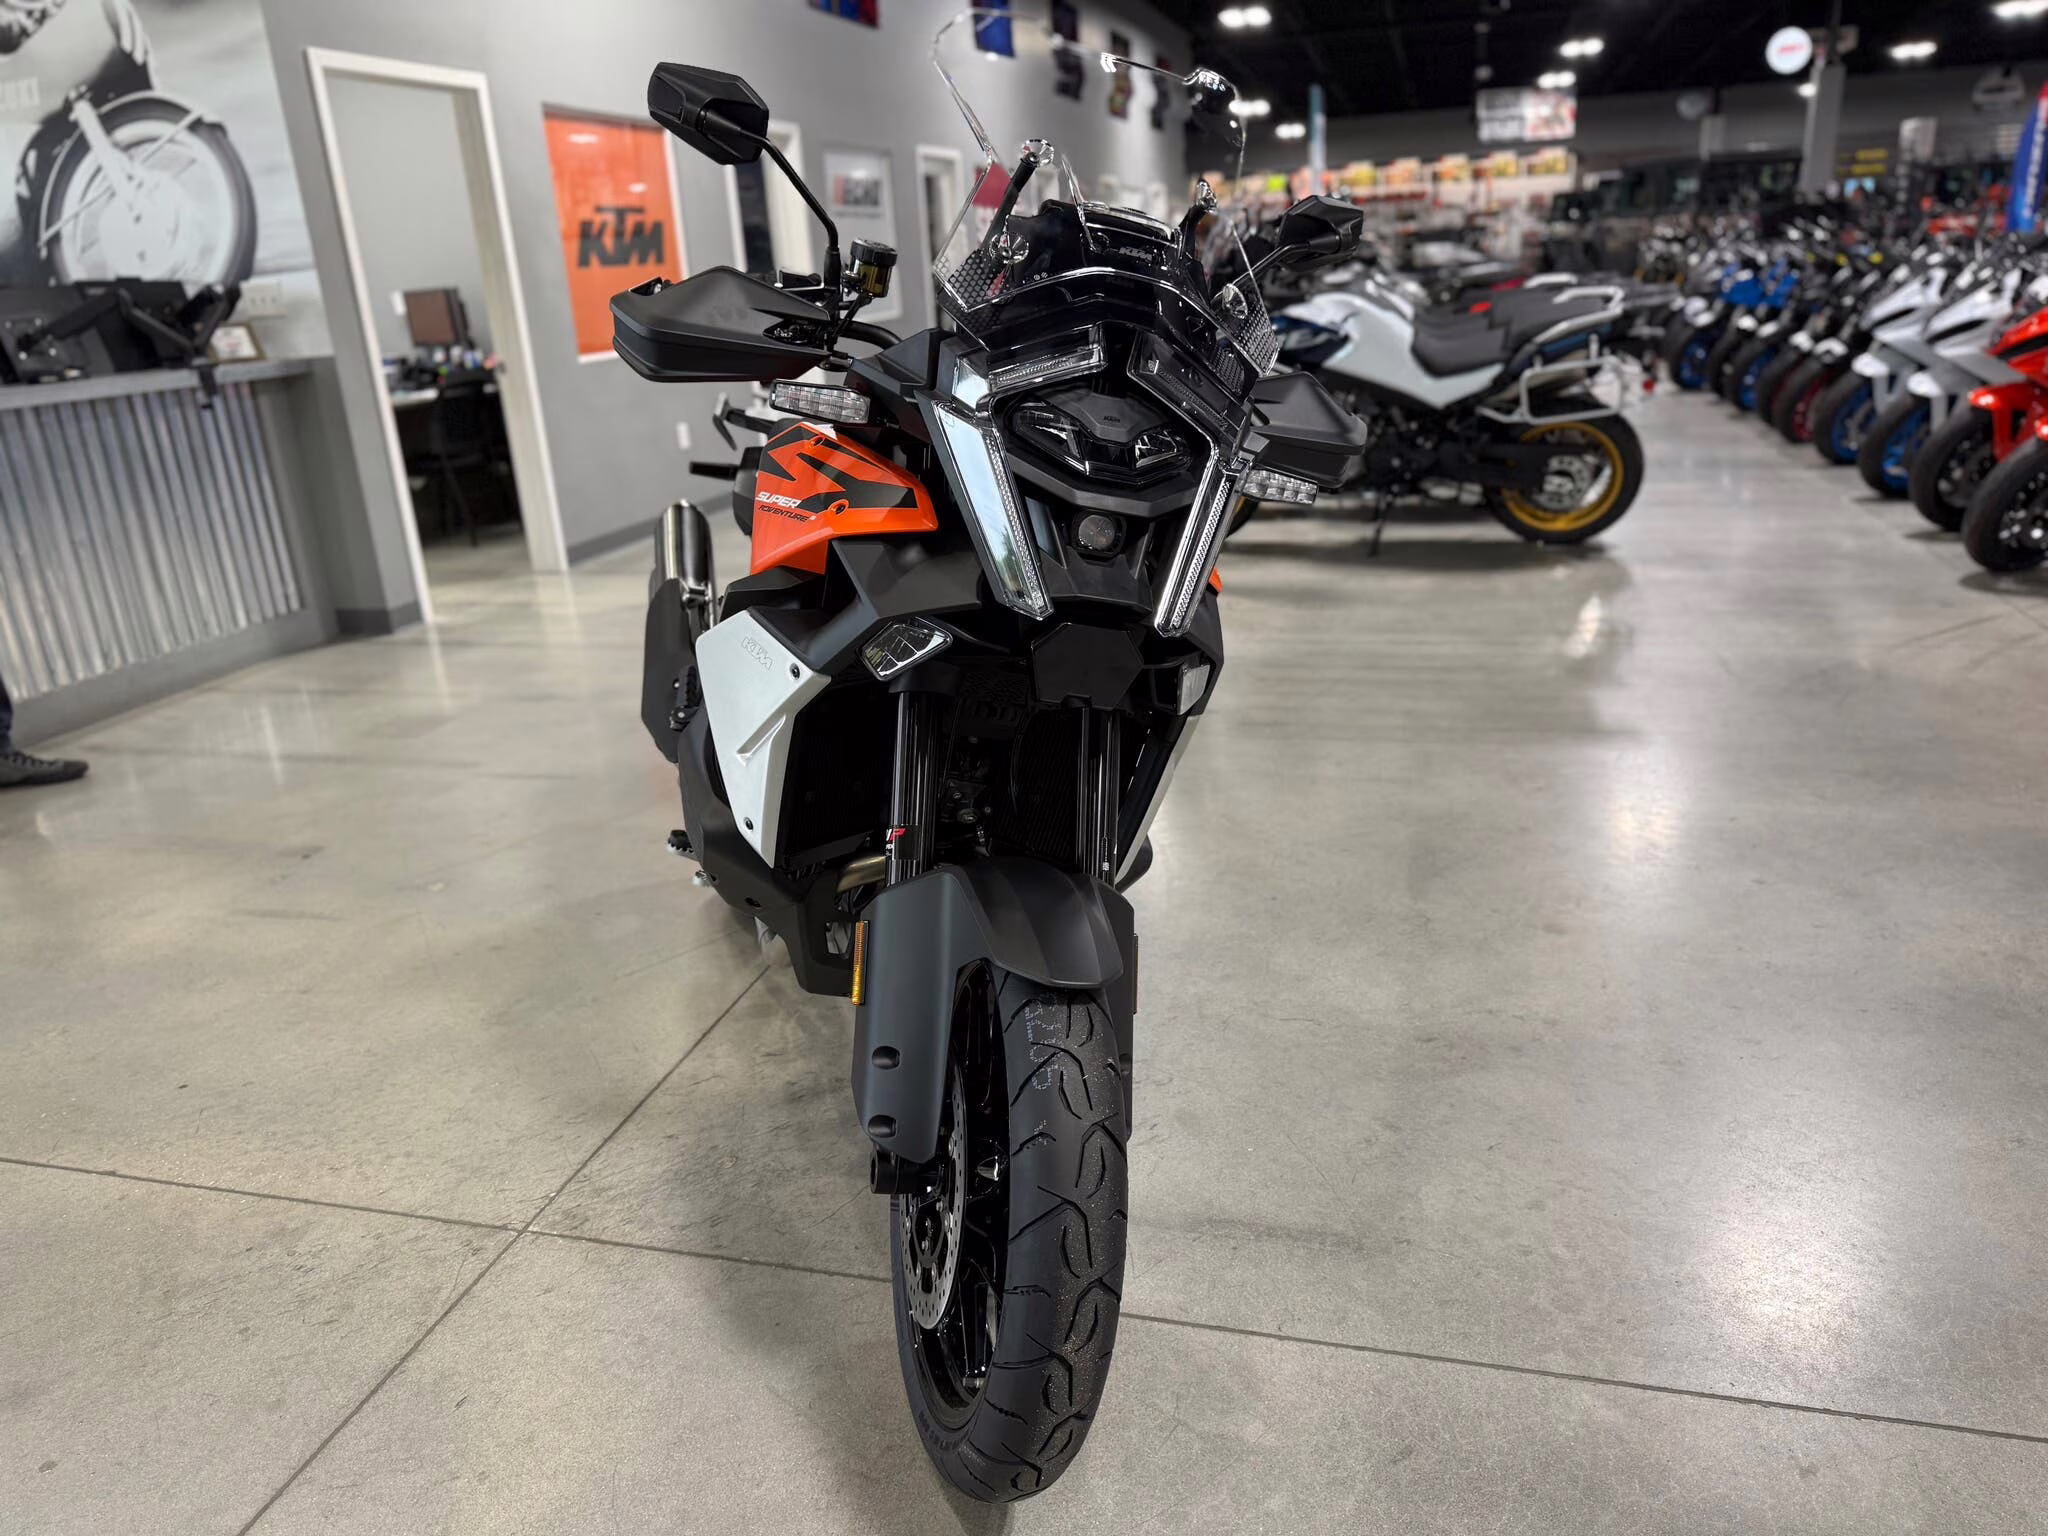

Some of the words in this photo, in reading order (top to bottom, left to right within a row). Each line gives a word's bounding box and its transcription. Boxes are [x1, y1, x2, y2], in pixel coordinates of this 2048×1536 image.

[578, 205, 664, 268] KTM
[755, 491, 802, 509] SUPER
[758, 504, 809, 522] ADVENTURE
[741, 636, 774, 670] KTM
